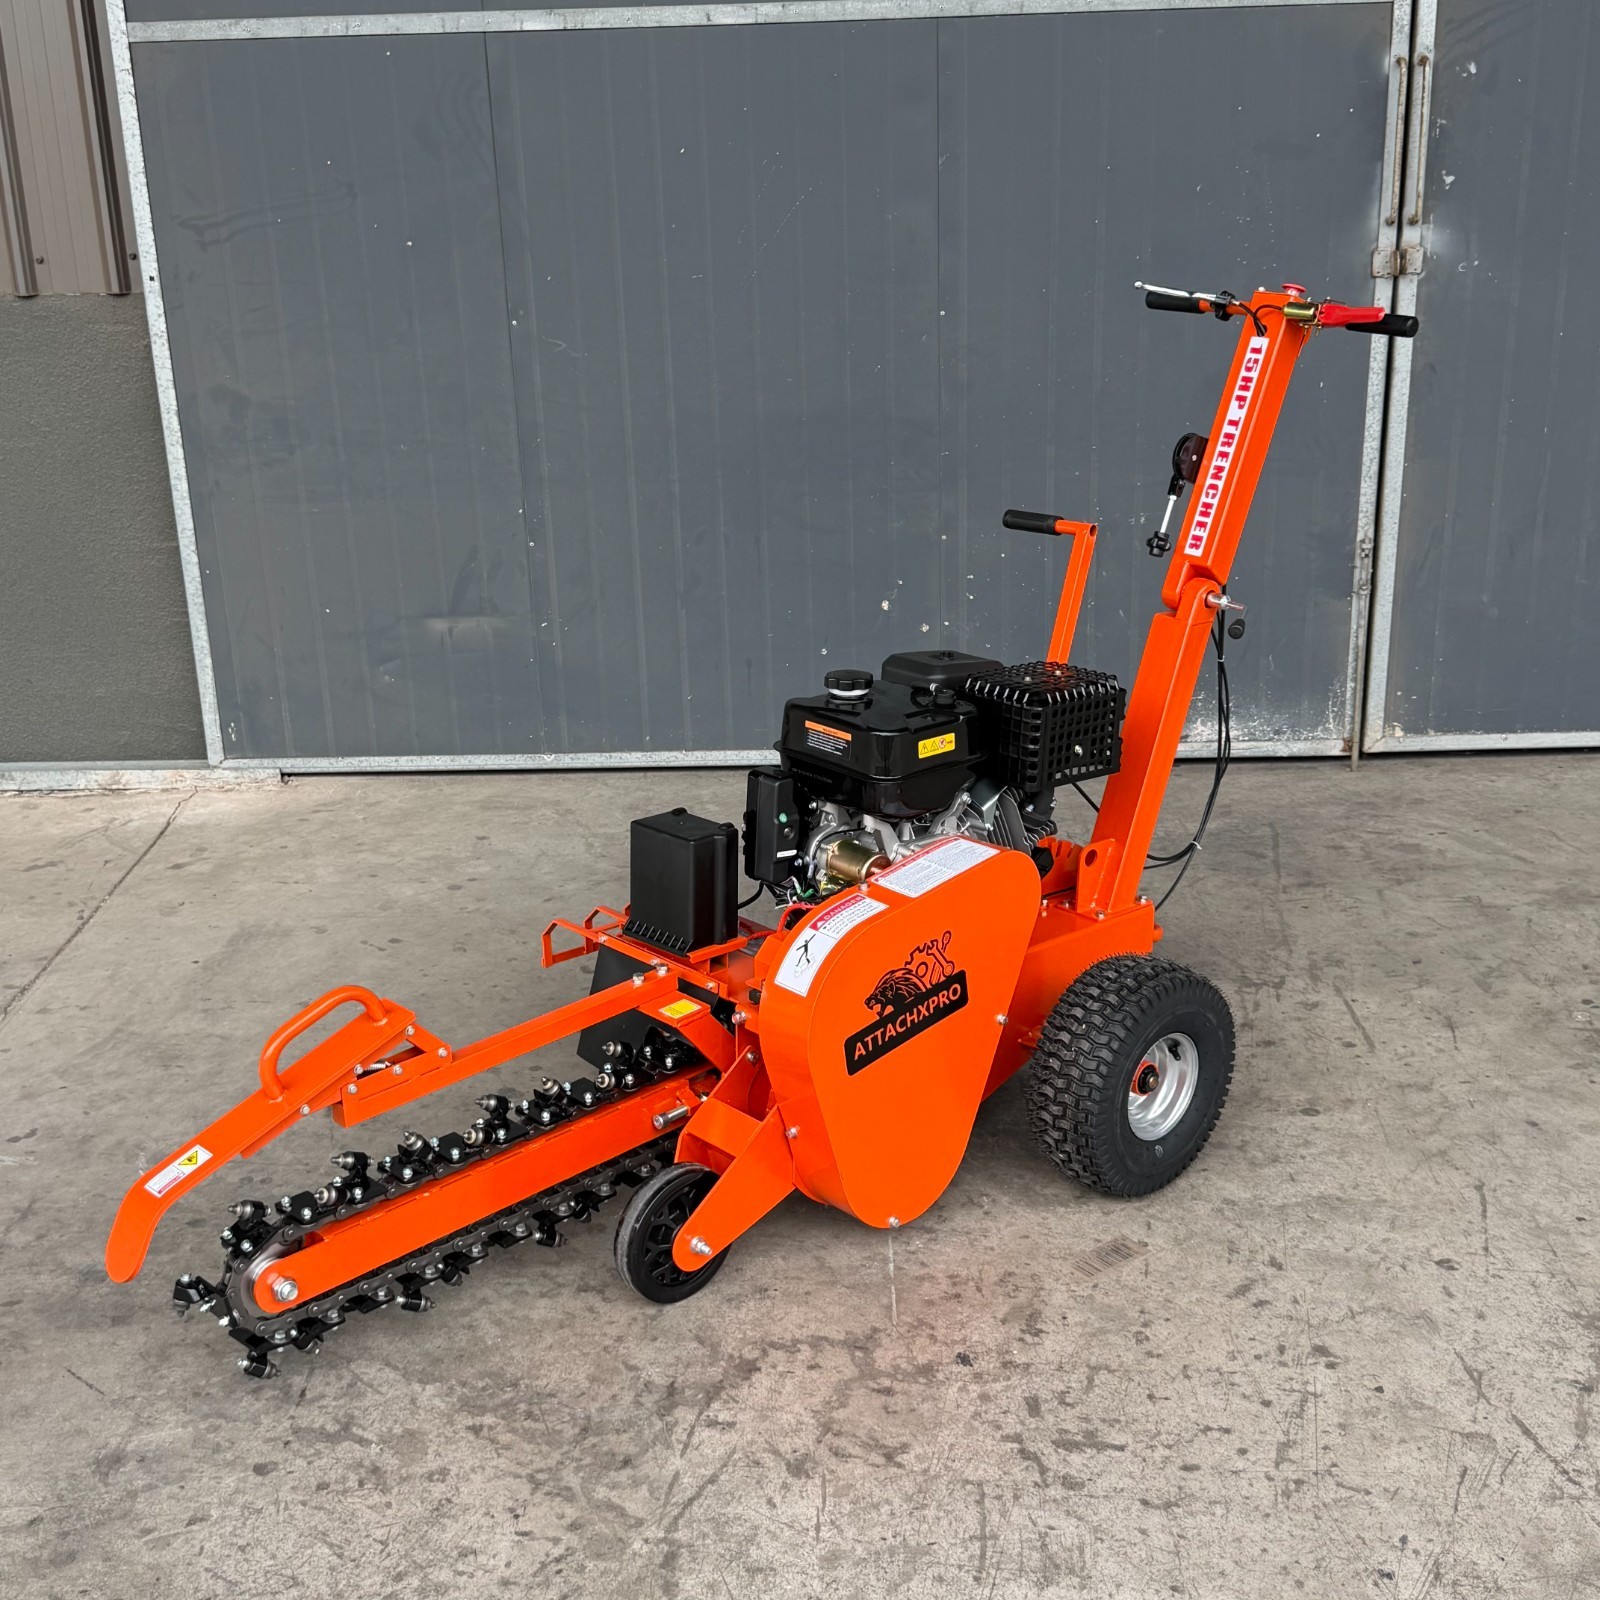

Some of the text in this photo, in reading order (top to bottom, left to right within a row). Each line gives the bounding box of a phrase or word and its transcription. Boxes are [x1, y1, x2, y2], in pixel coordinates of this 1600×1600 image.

[1188, 343, 1265, 551] 15HP TRENCHER
[853, 983, 962, 1060] ATTACHXPRO
